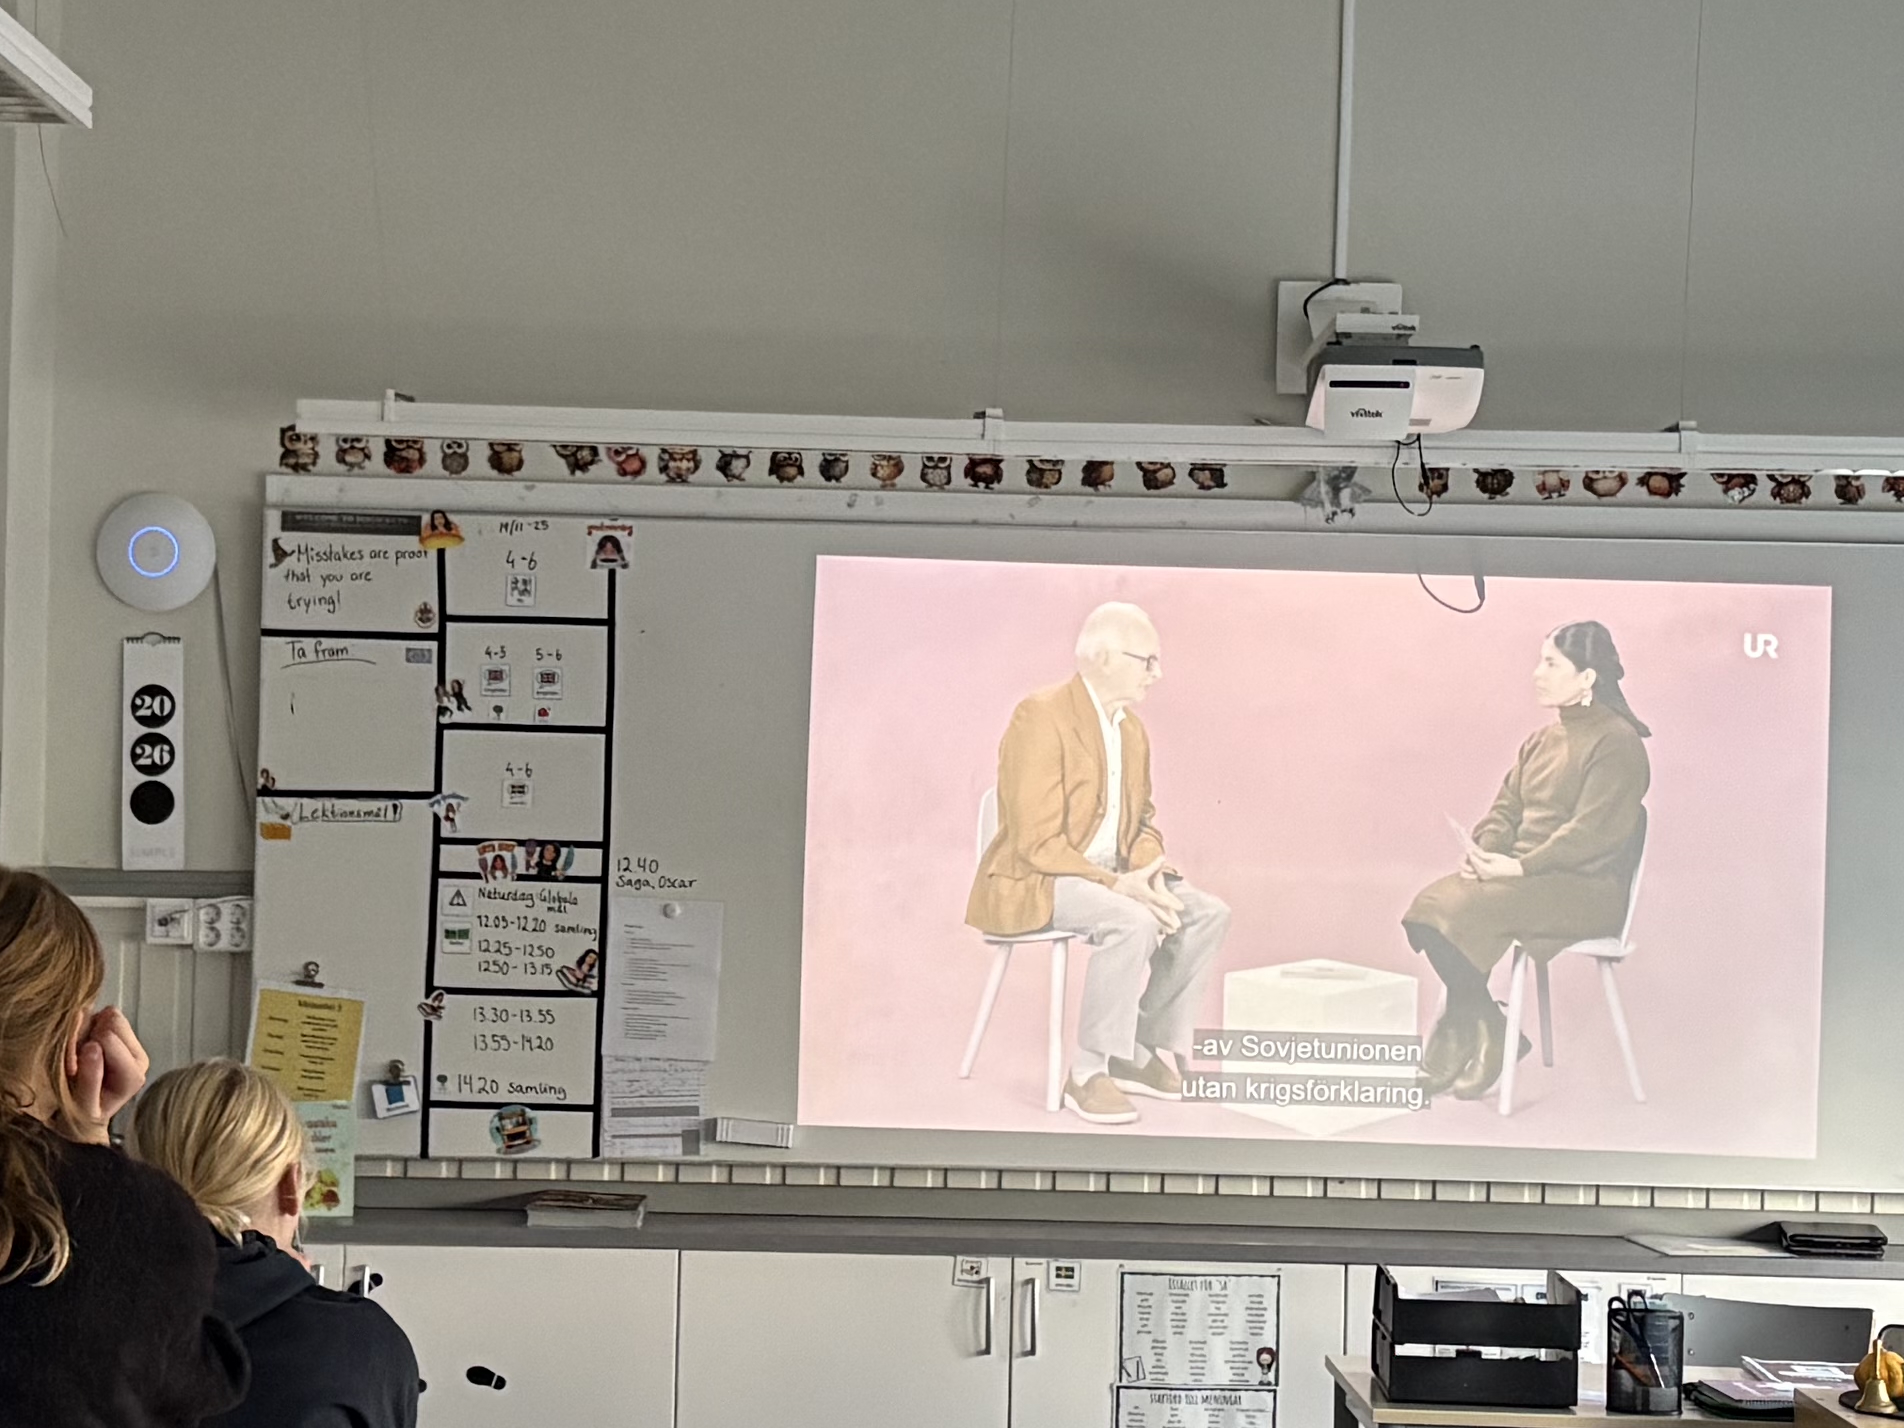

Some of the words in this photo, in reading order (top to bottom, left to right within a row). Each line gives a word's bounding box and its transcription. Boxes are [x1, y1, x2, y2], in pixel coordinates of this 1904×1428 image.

[369, 548, 390, 560] are
[284, 567, 311, 584] that
[320, 573, 344, 588] you
[350, 571, 372, 582] are
[286, 640, 307, 661] Ta
[314, 640, 349, 660] fram
[1743, 632, 1779, 659] UR
[134, 694, 172, 717] 20
[134, 743, 171, 766] 26
[658, 876, 697, 889] Oscar
[1193, 1037, 1234, 1057] -av
[1240, 1035, 1422, 1065] Sovjetunionen
[507, 1080, 567, 1101] samling
[1181, 1076, 1237, 1100] utan
[1246, 1077, 1431, 1110] krigsförklaring.
